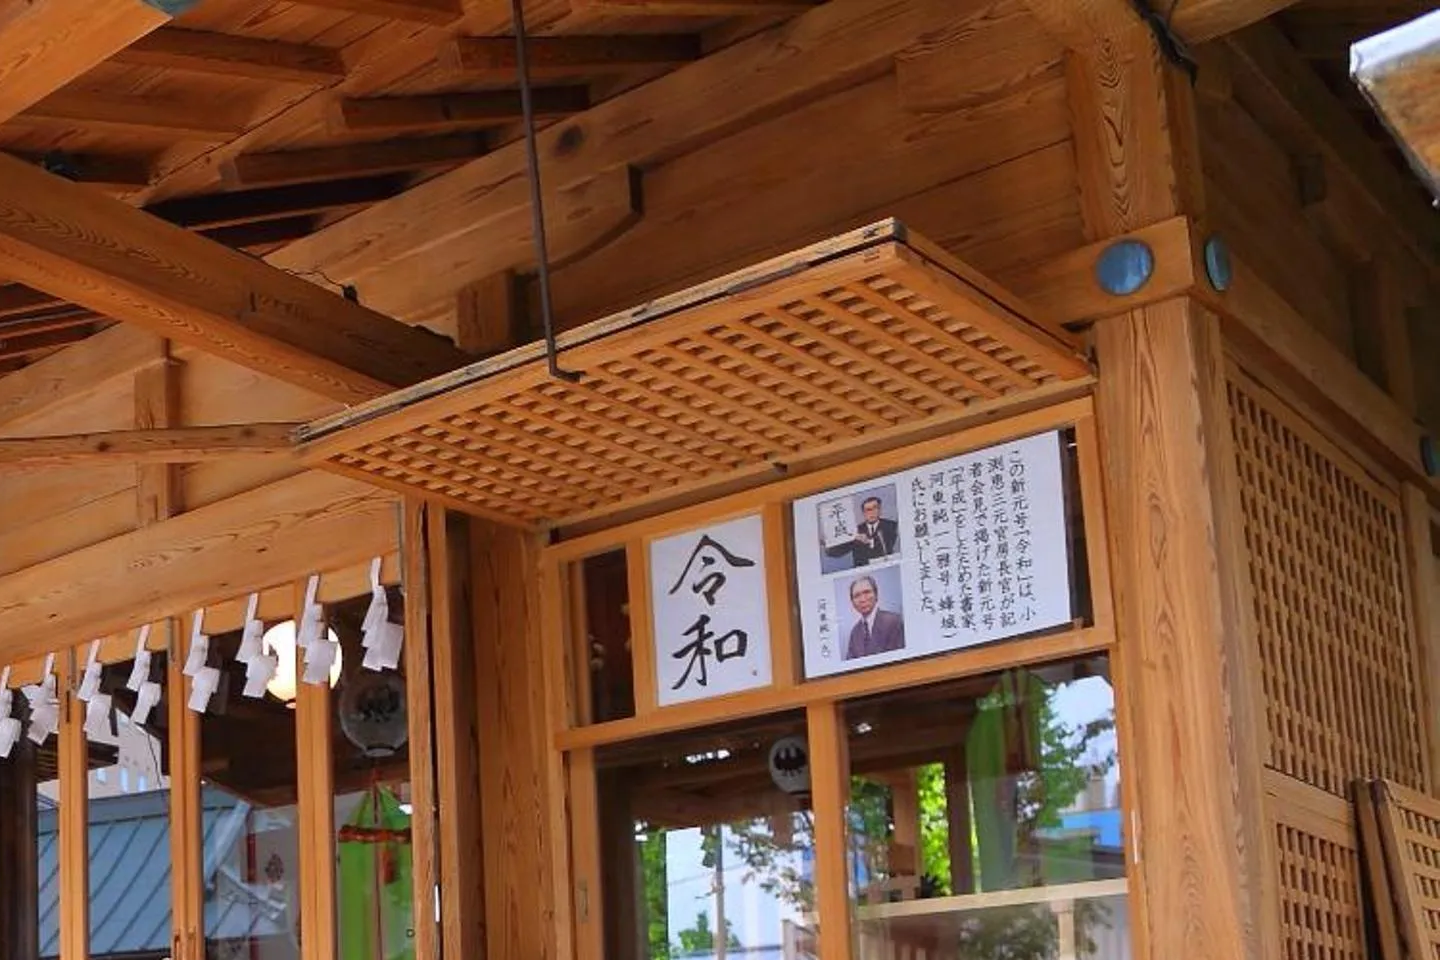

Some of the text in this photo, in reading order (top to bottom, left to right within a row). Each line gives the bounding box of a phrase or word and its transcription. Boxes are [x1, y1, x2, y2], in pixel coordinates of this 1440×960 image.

[669, 534, 756, 690] 令和
[969, 462, 996, 631] 者会見で掲げた新元号
